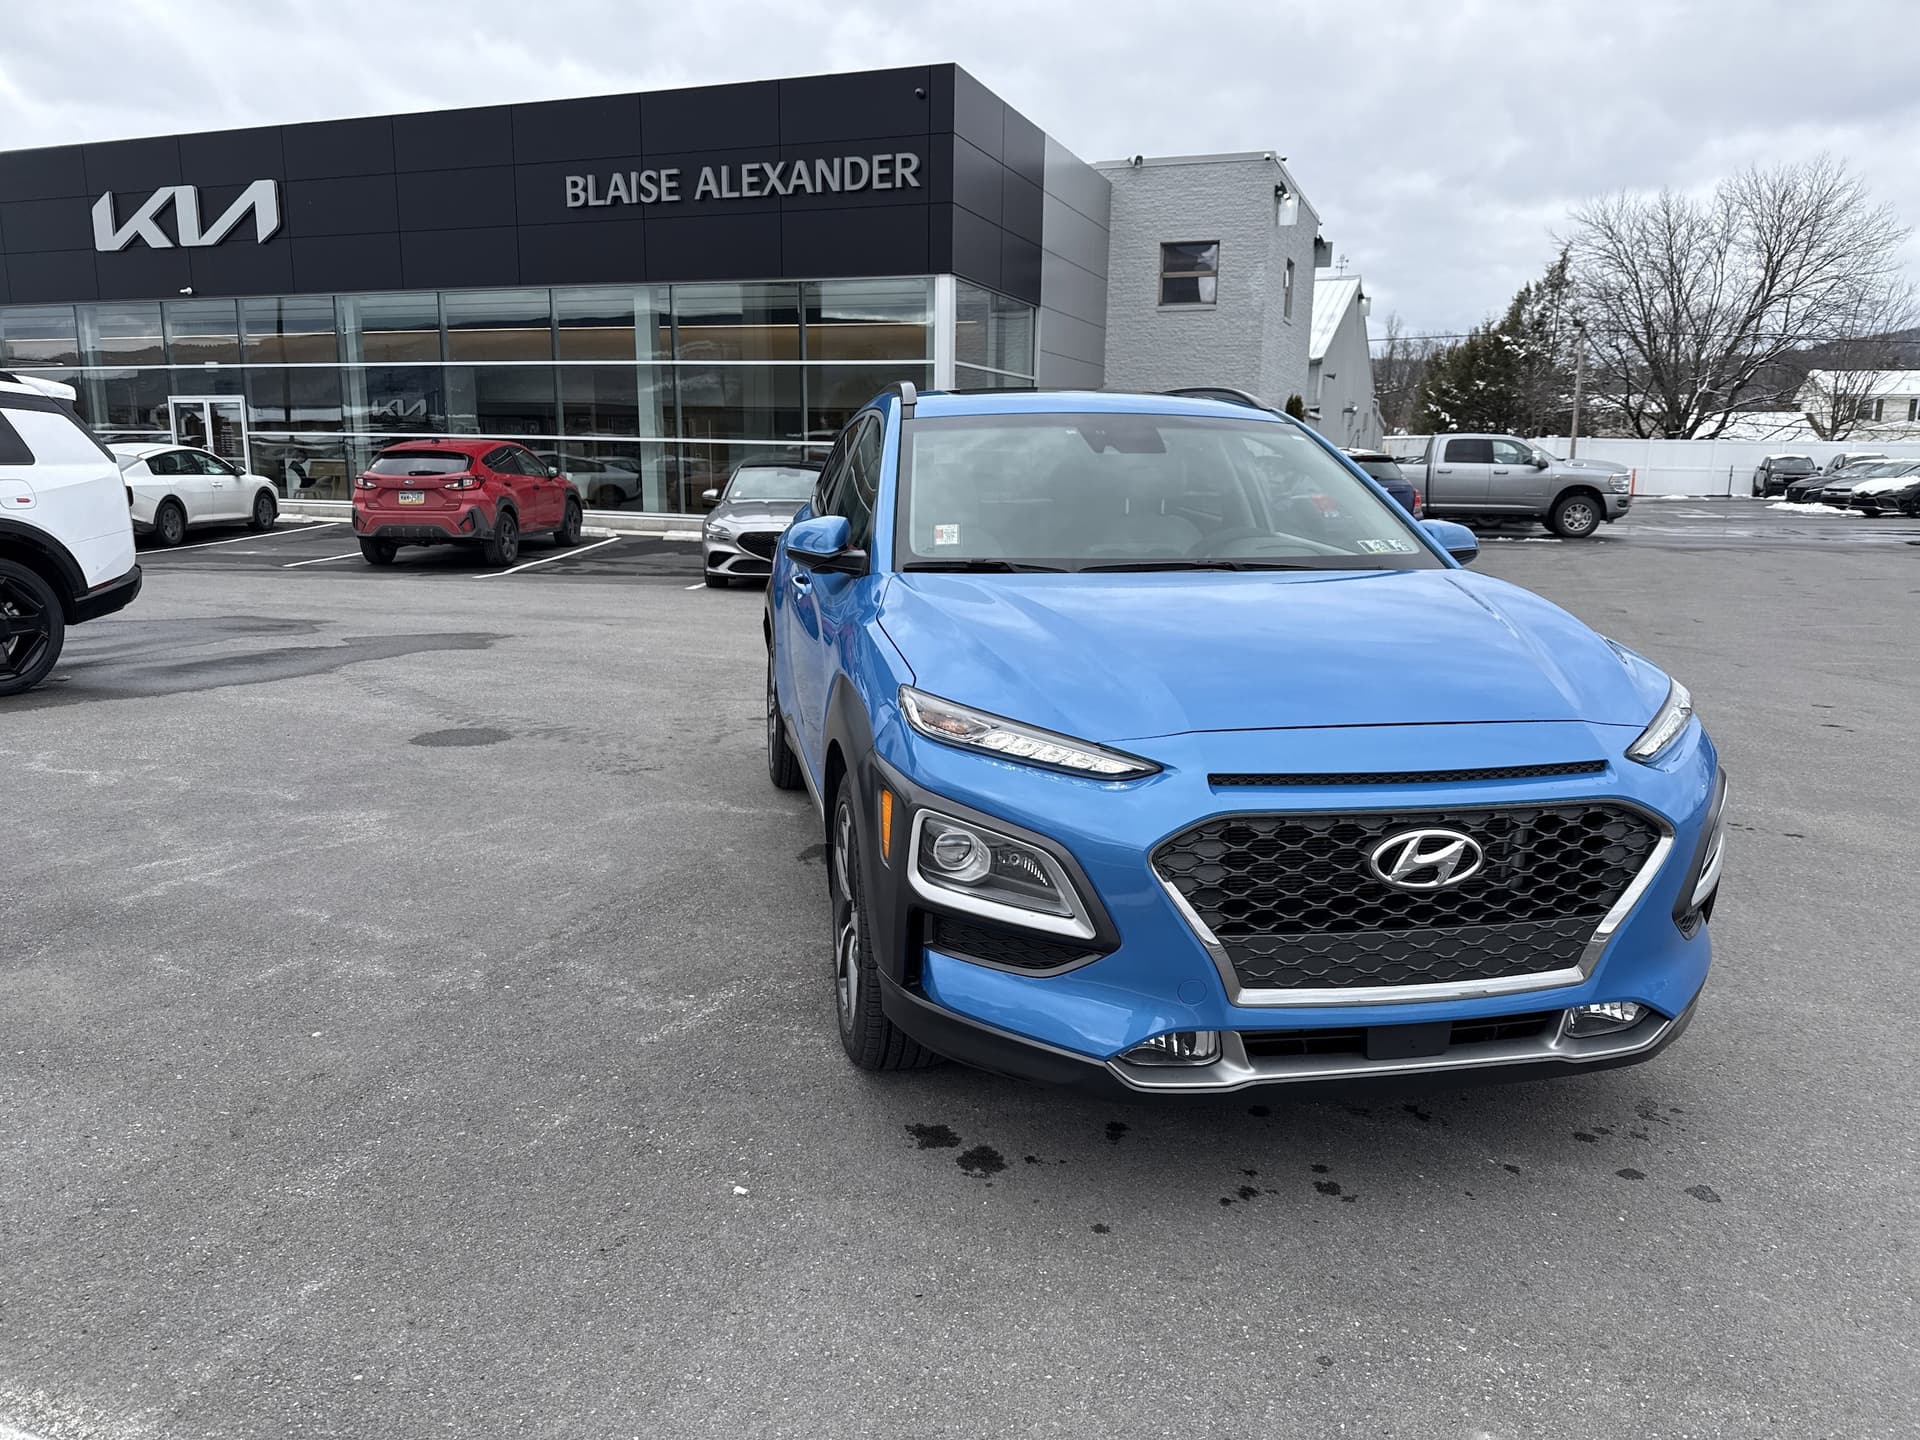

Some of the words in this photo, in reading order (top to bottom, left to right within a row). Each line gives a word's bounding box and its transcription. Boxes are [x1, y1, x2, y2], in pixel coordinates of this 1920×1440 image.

[565, 168, 681, 208] BLAISE
[694, 152, 922, 201] ALEXANDER
[91, 178, 281, 252] KIA
